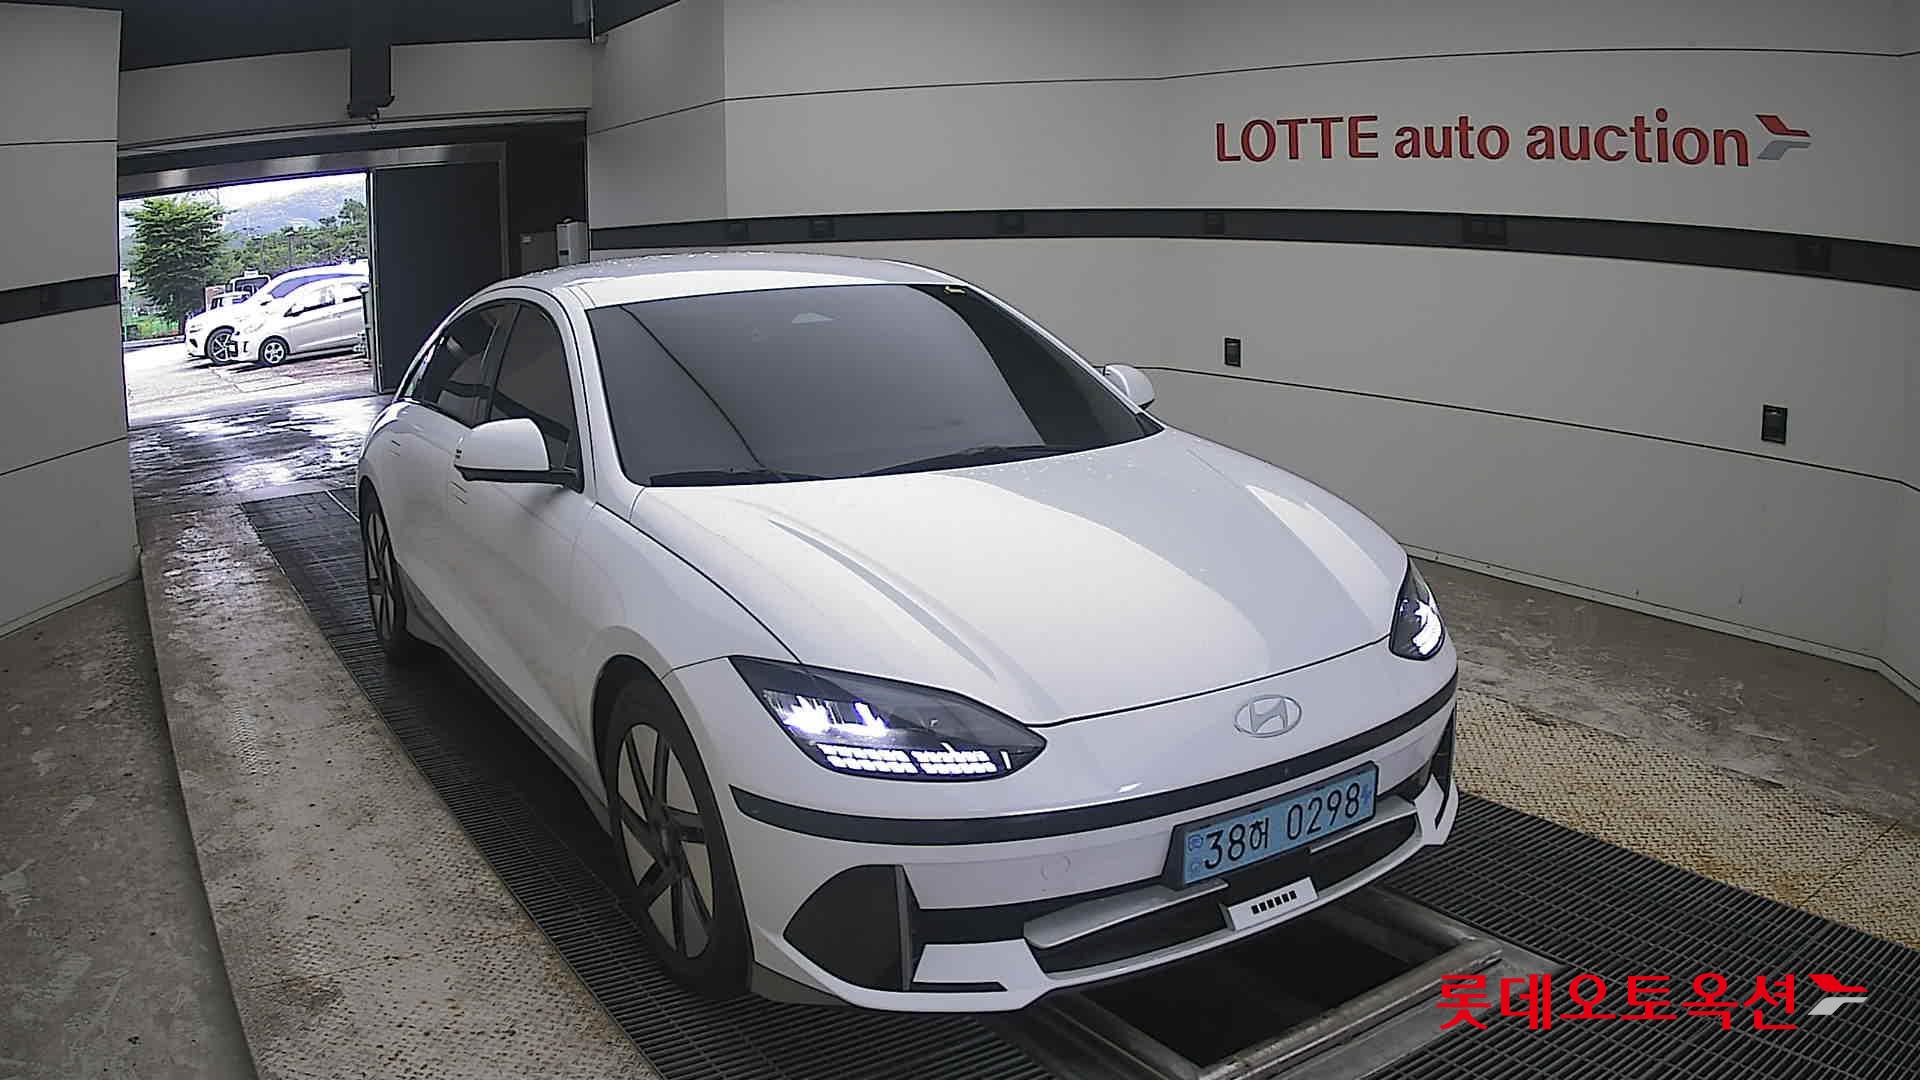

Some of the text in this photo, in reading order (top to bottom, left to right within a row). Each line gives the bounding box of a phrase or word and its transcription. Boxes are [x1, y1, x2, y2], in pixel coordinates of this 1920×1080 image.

[1216, 108, 1749, 166] LOTTE auto auction
[1204, 782, 1361, 870] 38허 0298
